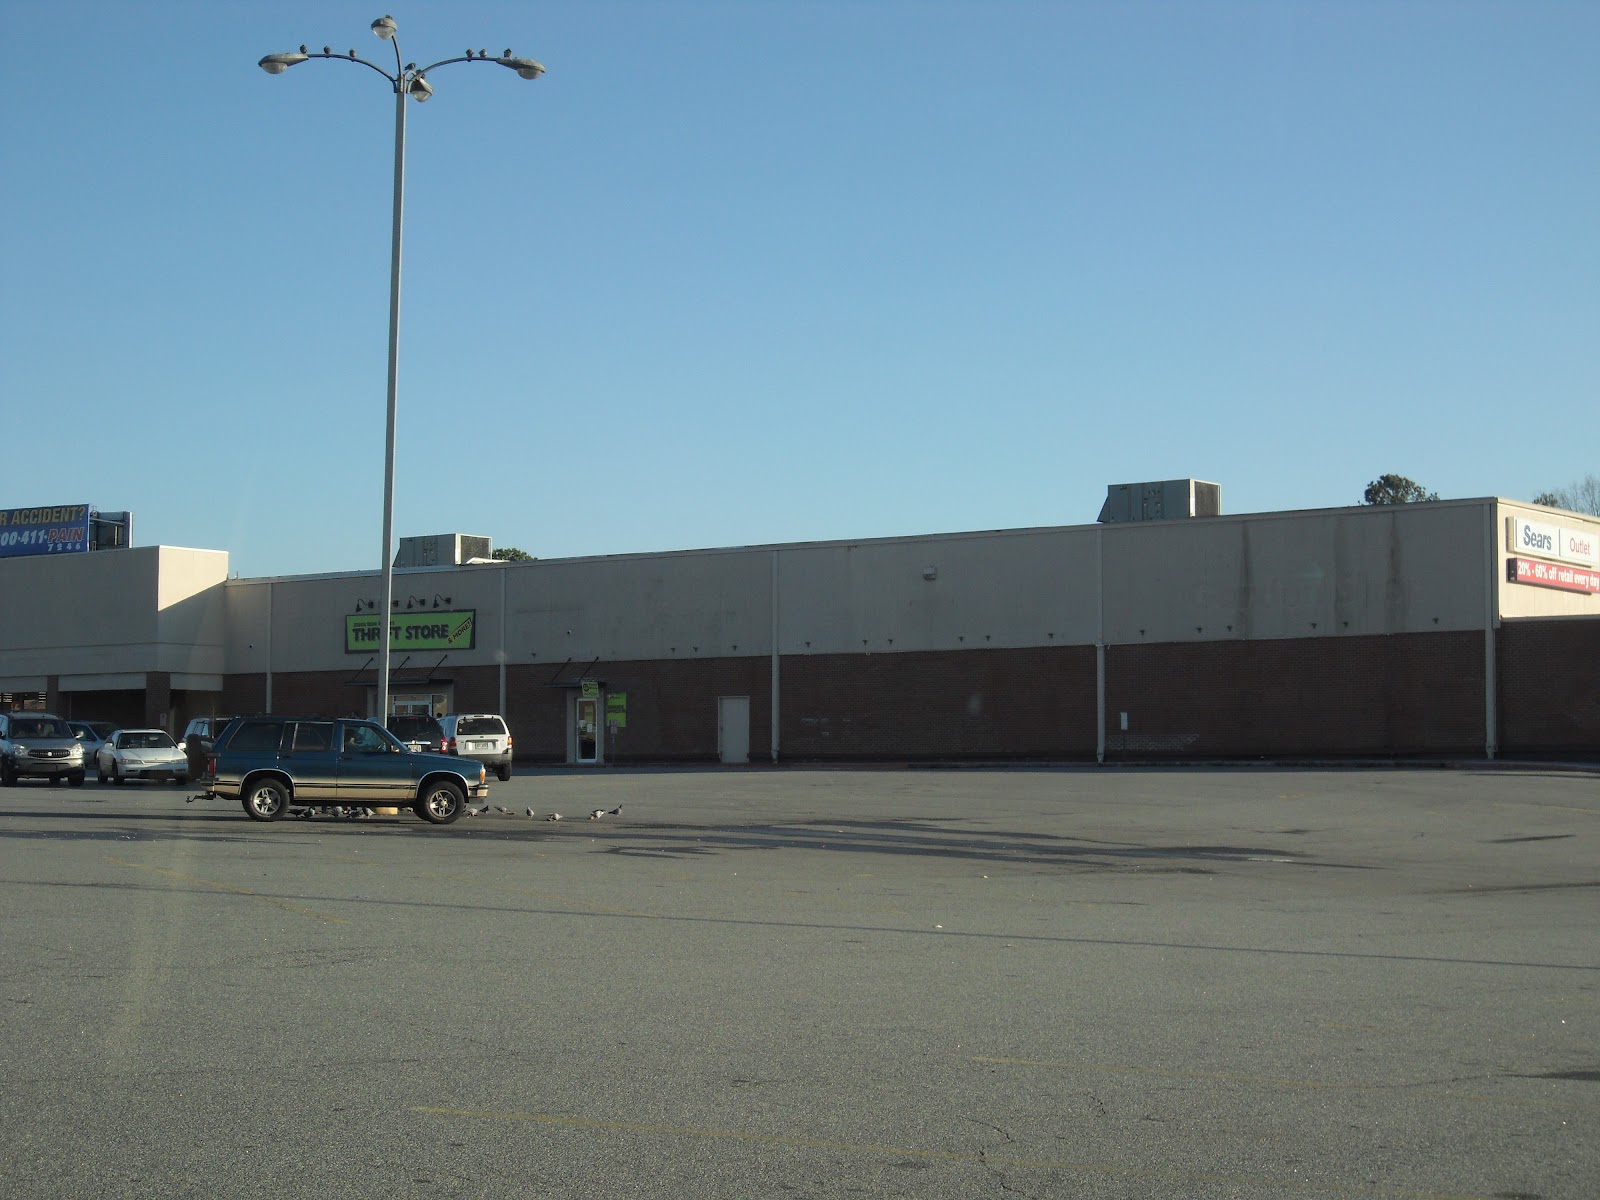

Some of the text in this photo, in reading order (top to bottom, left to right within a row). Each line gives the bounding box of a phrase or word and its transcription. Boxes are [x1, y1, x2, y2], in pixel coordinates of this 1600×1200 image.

[11, 506, 86, 525] ACCIDENT?
[1523, 524, 1552, 550] Sears
[1569, 537, 1591, 556] Outlet
[1548, 566, 1557, 580] off
[1558, 567, 1574, 583] retail
[1574, 573, 1589, 589] every
[1590, 573, 1600, 590] day
[405, 624, 449, 640] STORE
